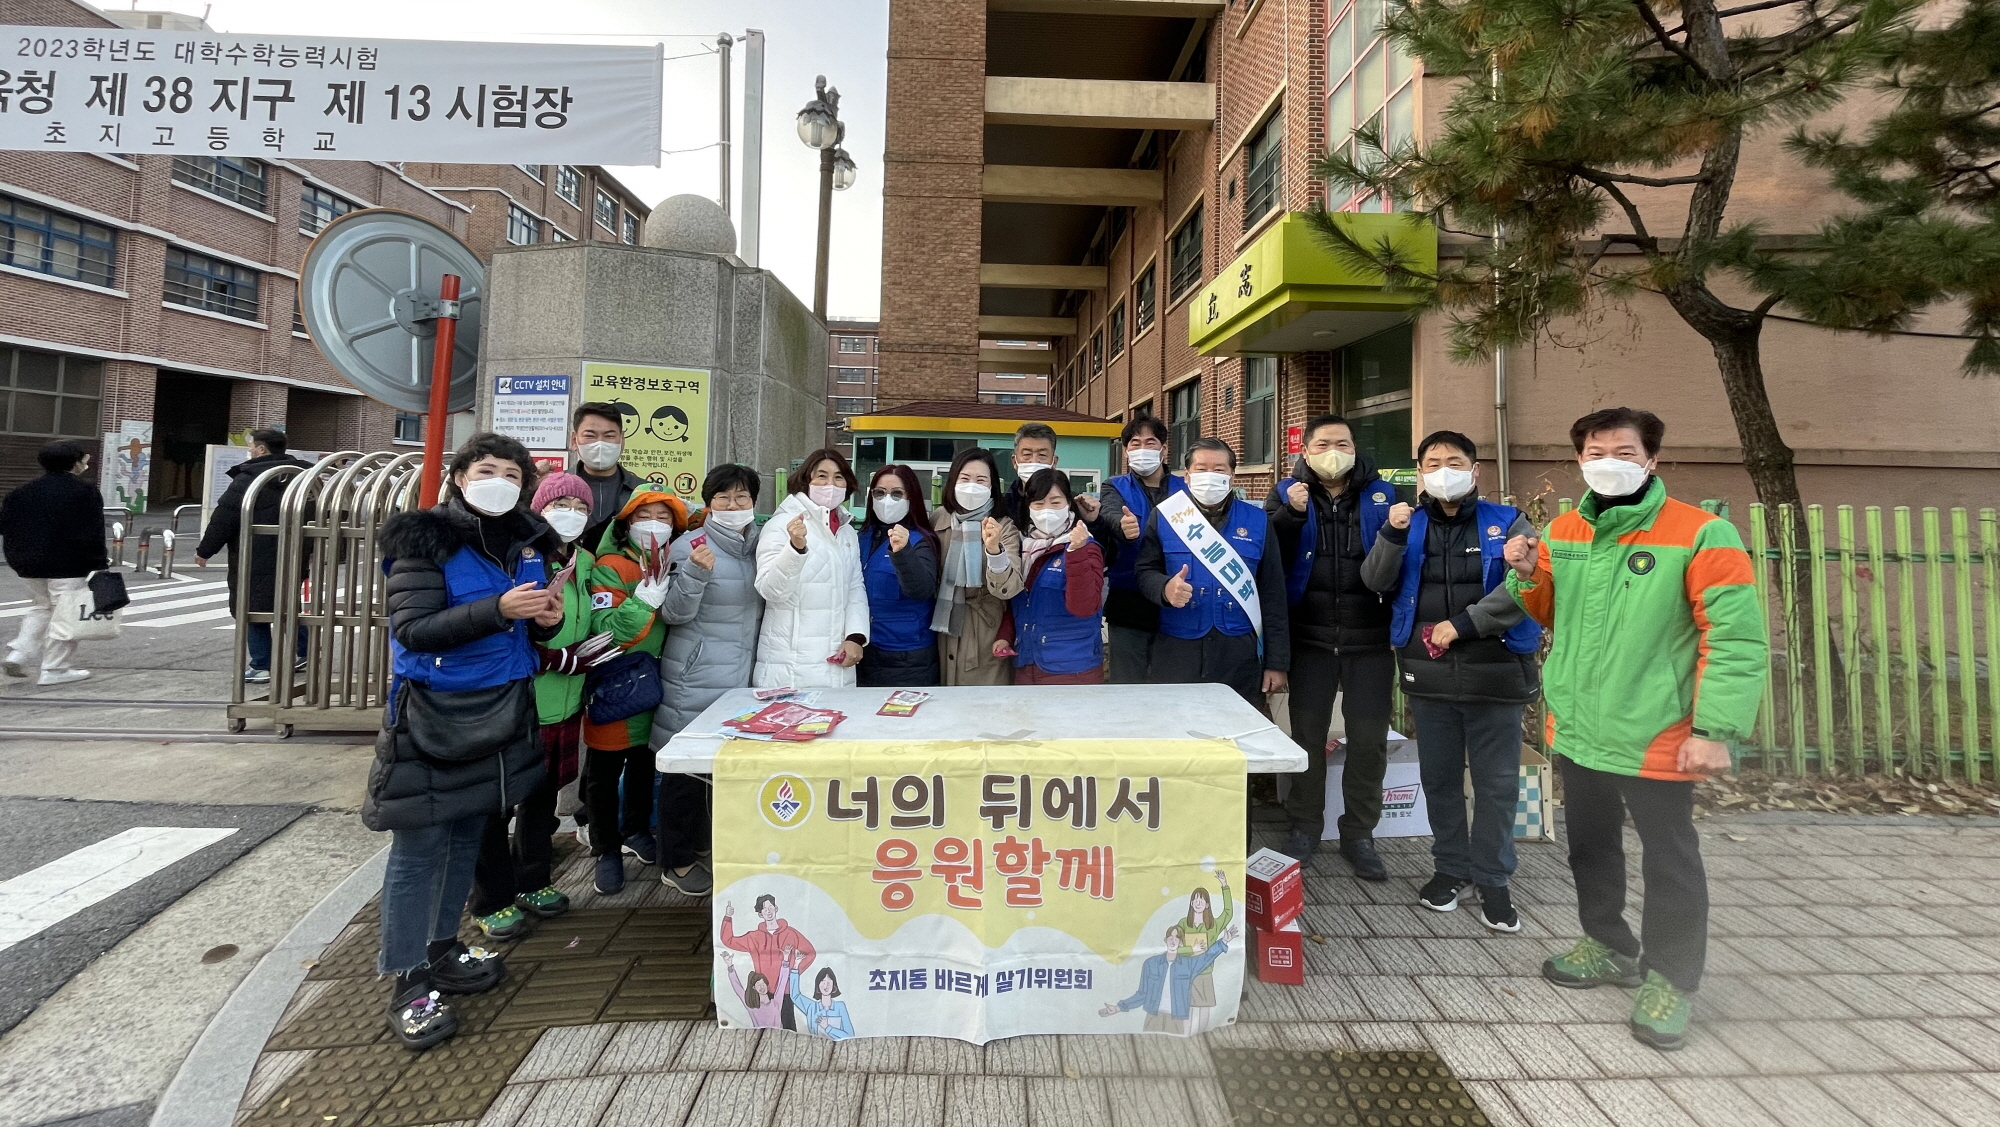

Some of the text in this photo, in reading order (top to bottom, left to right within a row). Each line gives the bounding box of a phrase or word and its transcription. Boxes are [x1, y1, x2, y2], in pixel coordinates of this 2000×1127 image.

[17, 37, 378, 71] 2023학년도 대학수학능력시험
[86, 72, 129, 117] 제
[142, 75, 193, 114] 38
[209, 77, 296, 122] 지구
[323, 80, 366, 125] 제
[384, 84, 431, 122] 13
[445, 84, 574, 129] 시험장
[514, 379, 566, 391] CCTV 설치 안내
[590, 374, 700, 394] 교육환경보호구역
[827, 774, 1161, 830] 너의 뒤에서
[872, 836, 1113, 909] 응원할께
[868, 967, 1093, 998] 초지동 바르게 살기위원회
